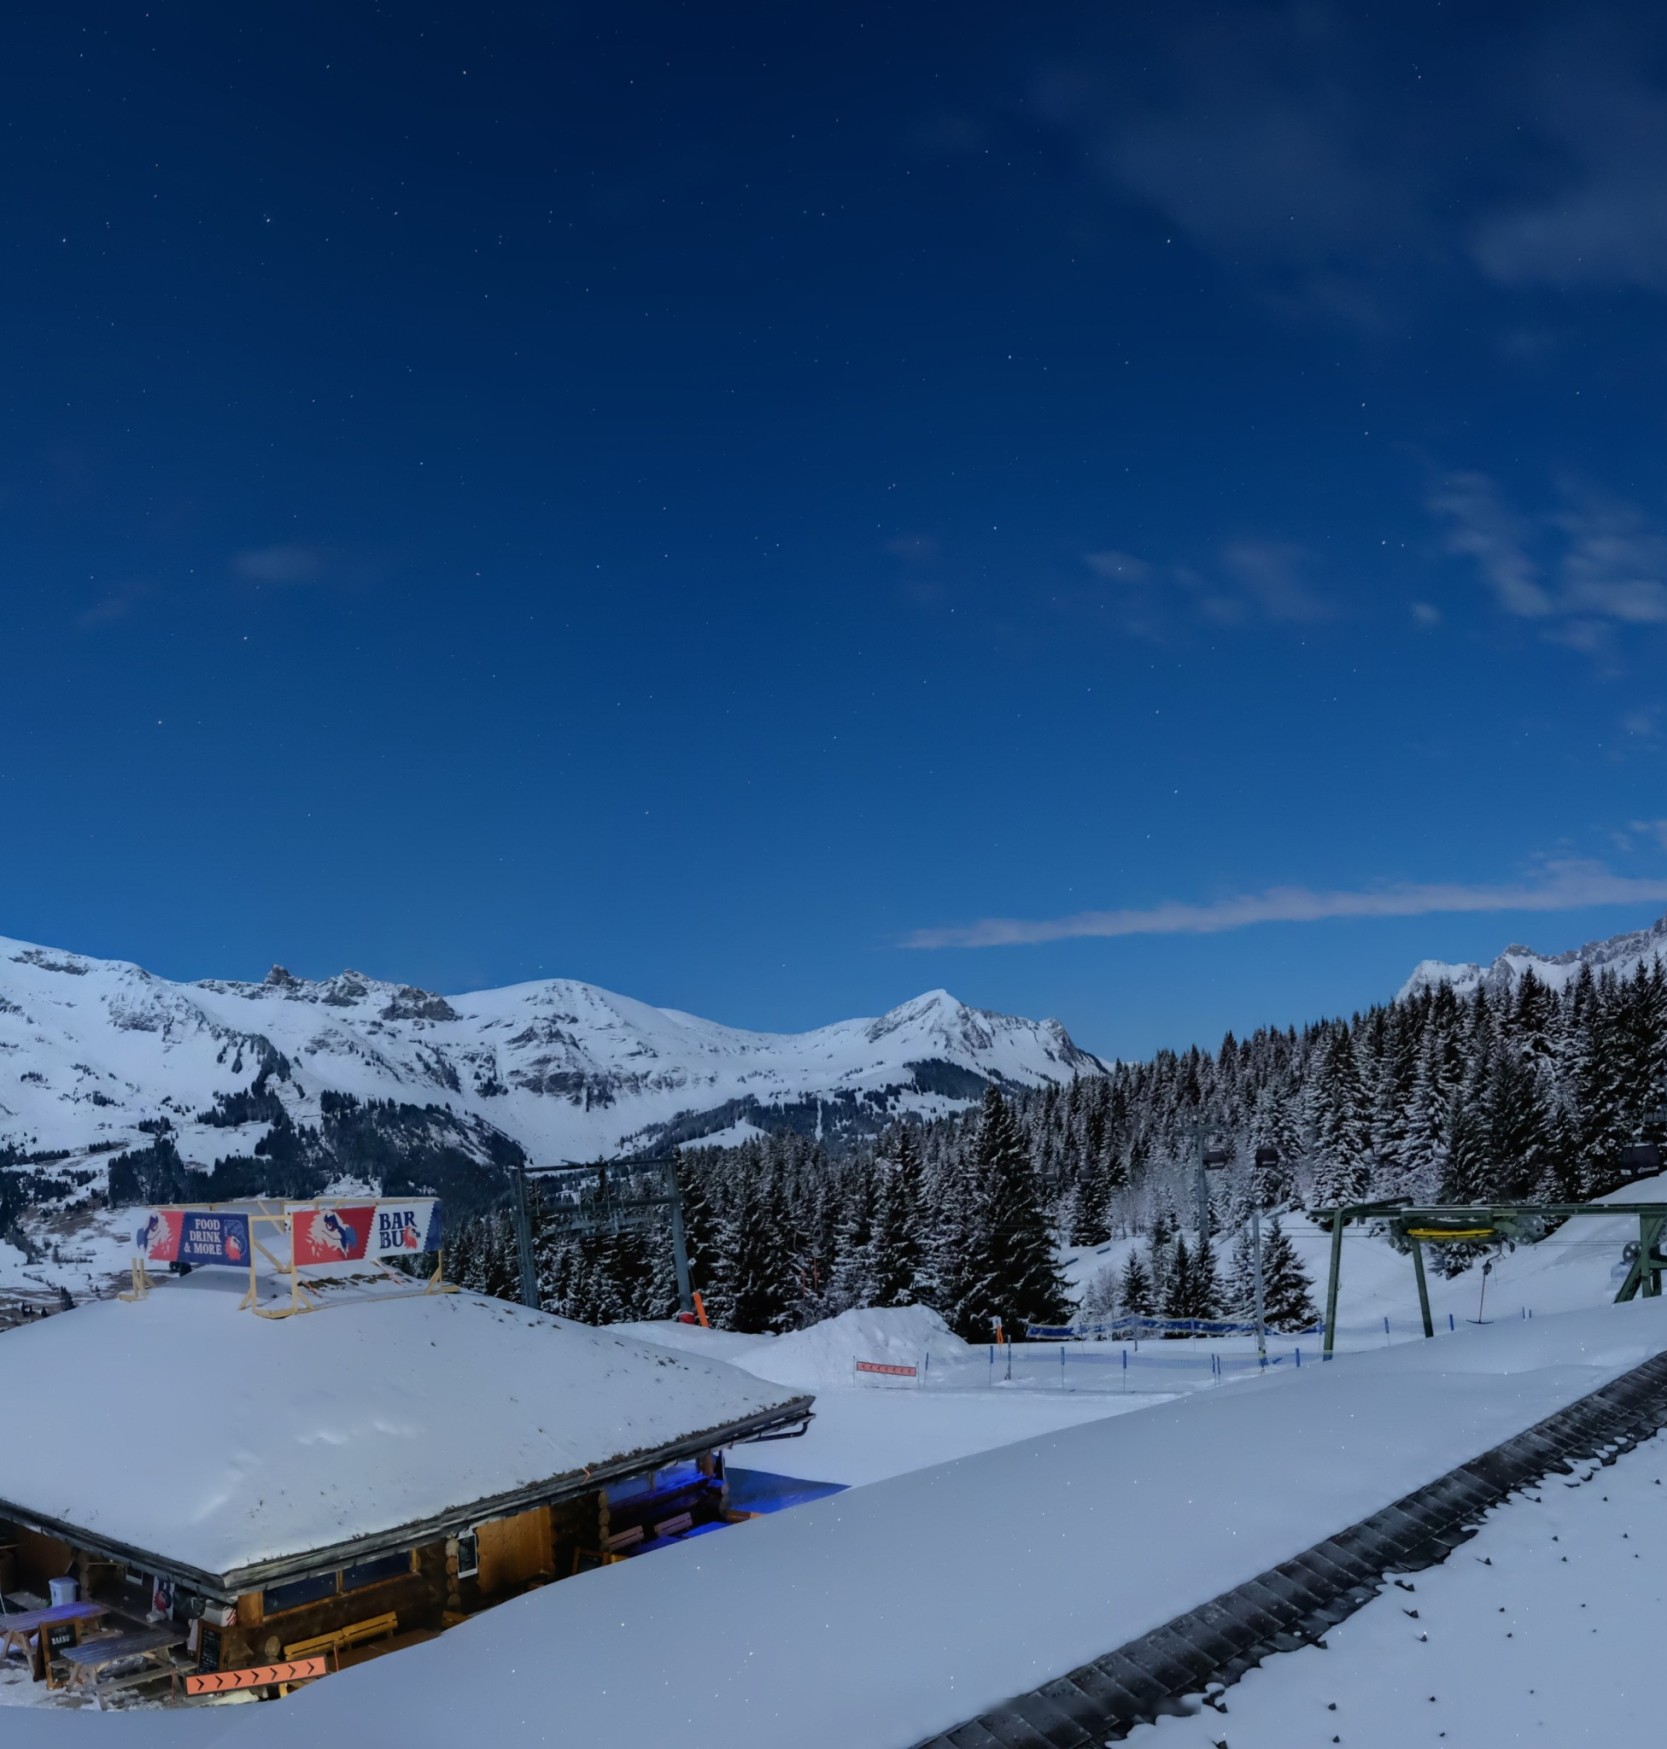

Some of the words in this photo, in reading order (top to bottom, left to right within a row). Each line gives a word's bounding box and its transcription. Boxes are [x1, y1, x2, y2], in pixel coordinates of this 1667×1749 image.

[195, 1219, 221, 1230] FOOD
[379, 1211, 417, 1231] BAR
[189, 1231, 221, 1243] DRINK
[184, 1243, 191, 1253] &
[193, 1243, 222, 1255] MORE
